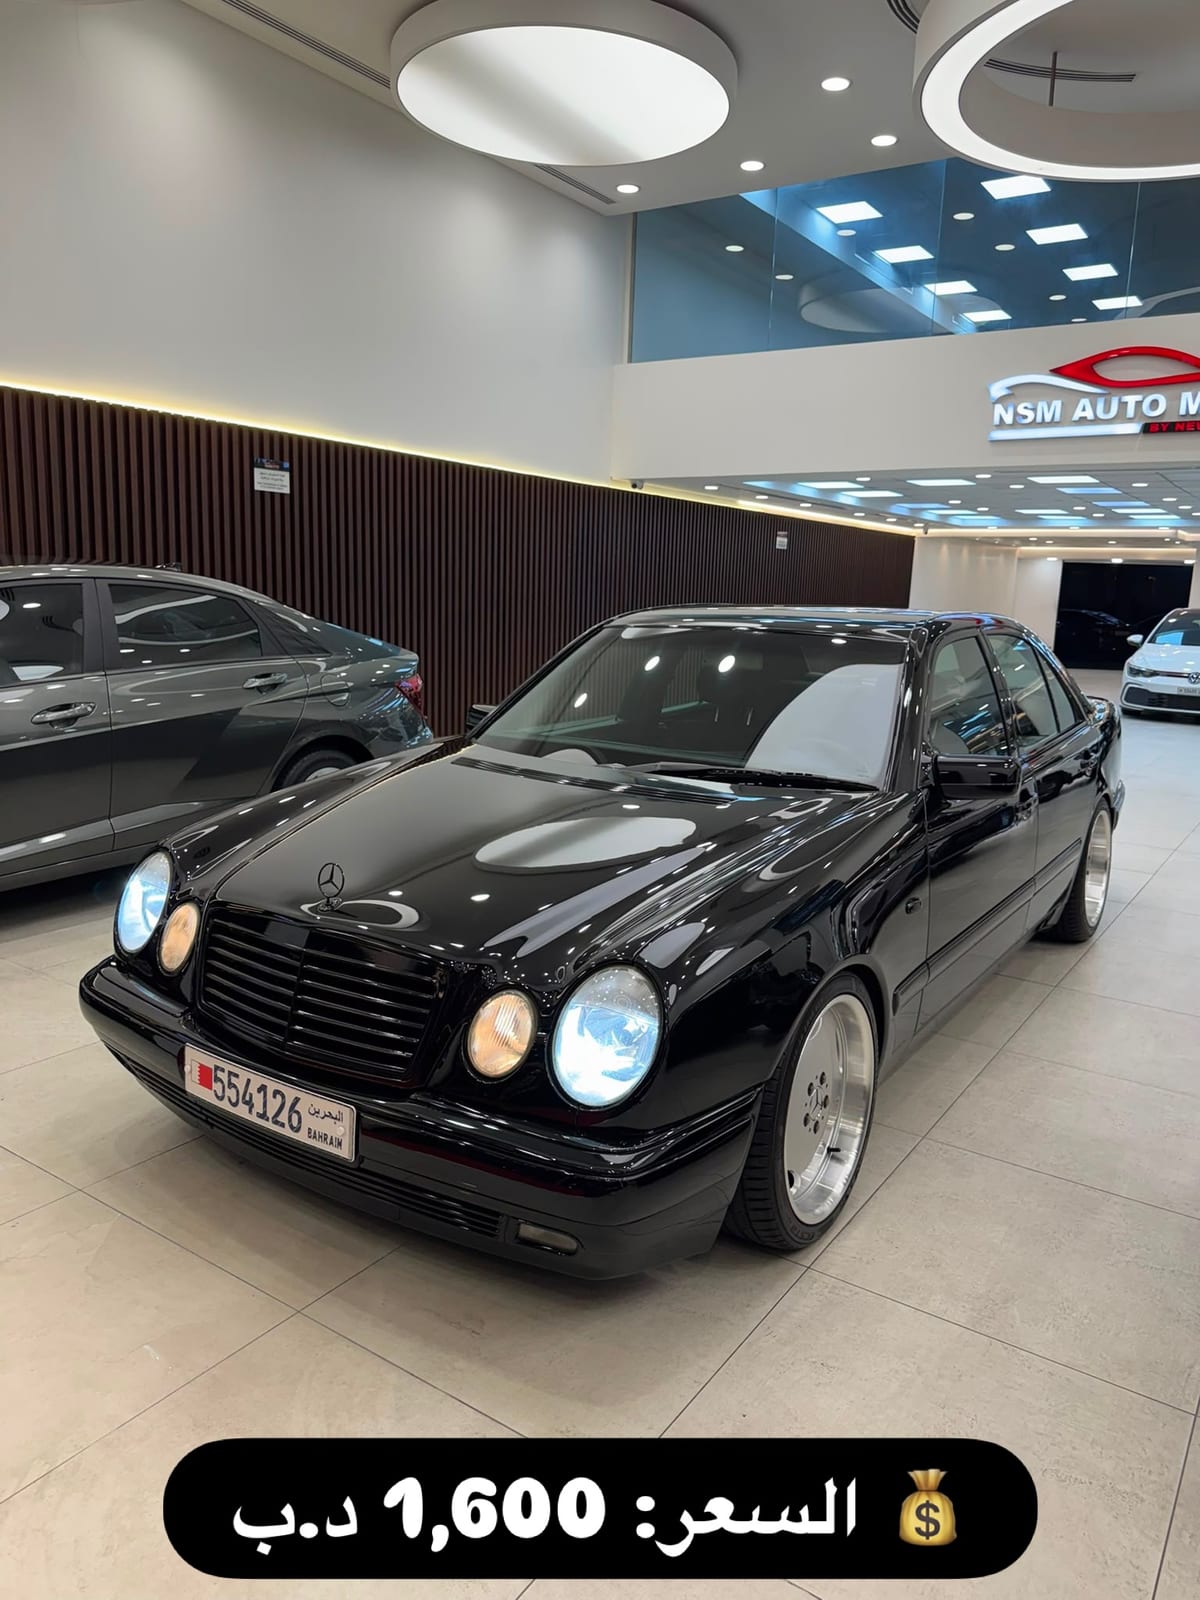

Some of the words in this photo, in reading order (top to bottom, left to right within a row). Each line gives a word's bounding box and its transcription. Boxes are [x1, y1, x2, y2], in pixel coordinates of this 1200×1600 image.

[993, 400, 1062, 426] NSM
[1072, 393, 1167, 422] AUTO
[1149, 422, 1169, 433] BY
[213, 1064, 303, 1133] 554126
[307, 1103, 344, 1125] البحرين
[307, 1127, 343, 1150] BAHRAIN
